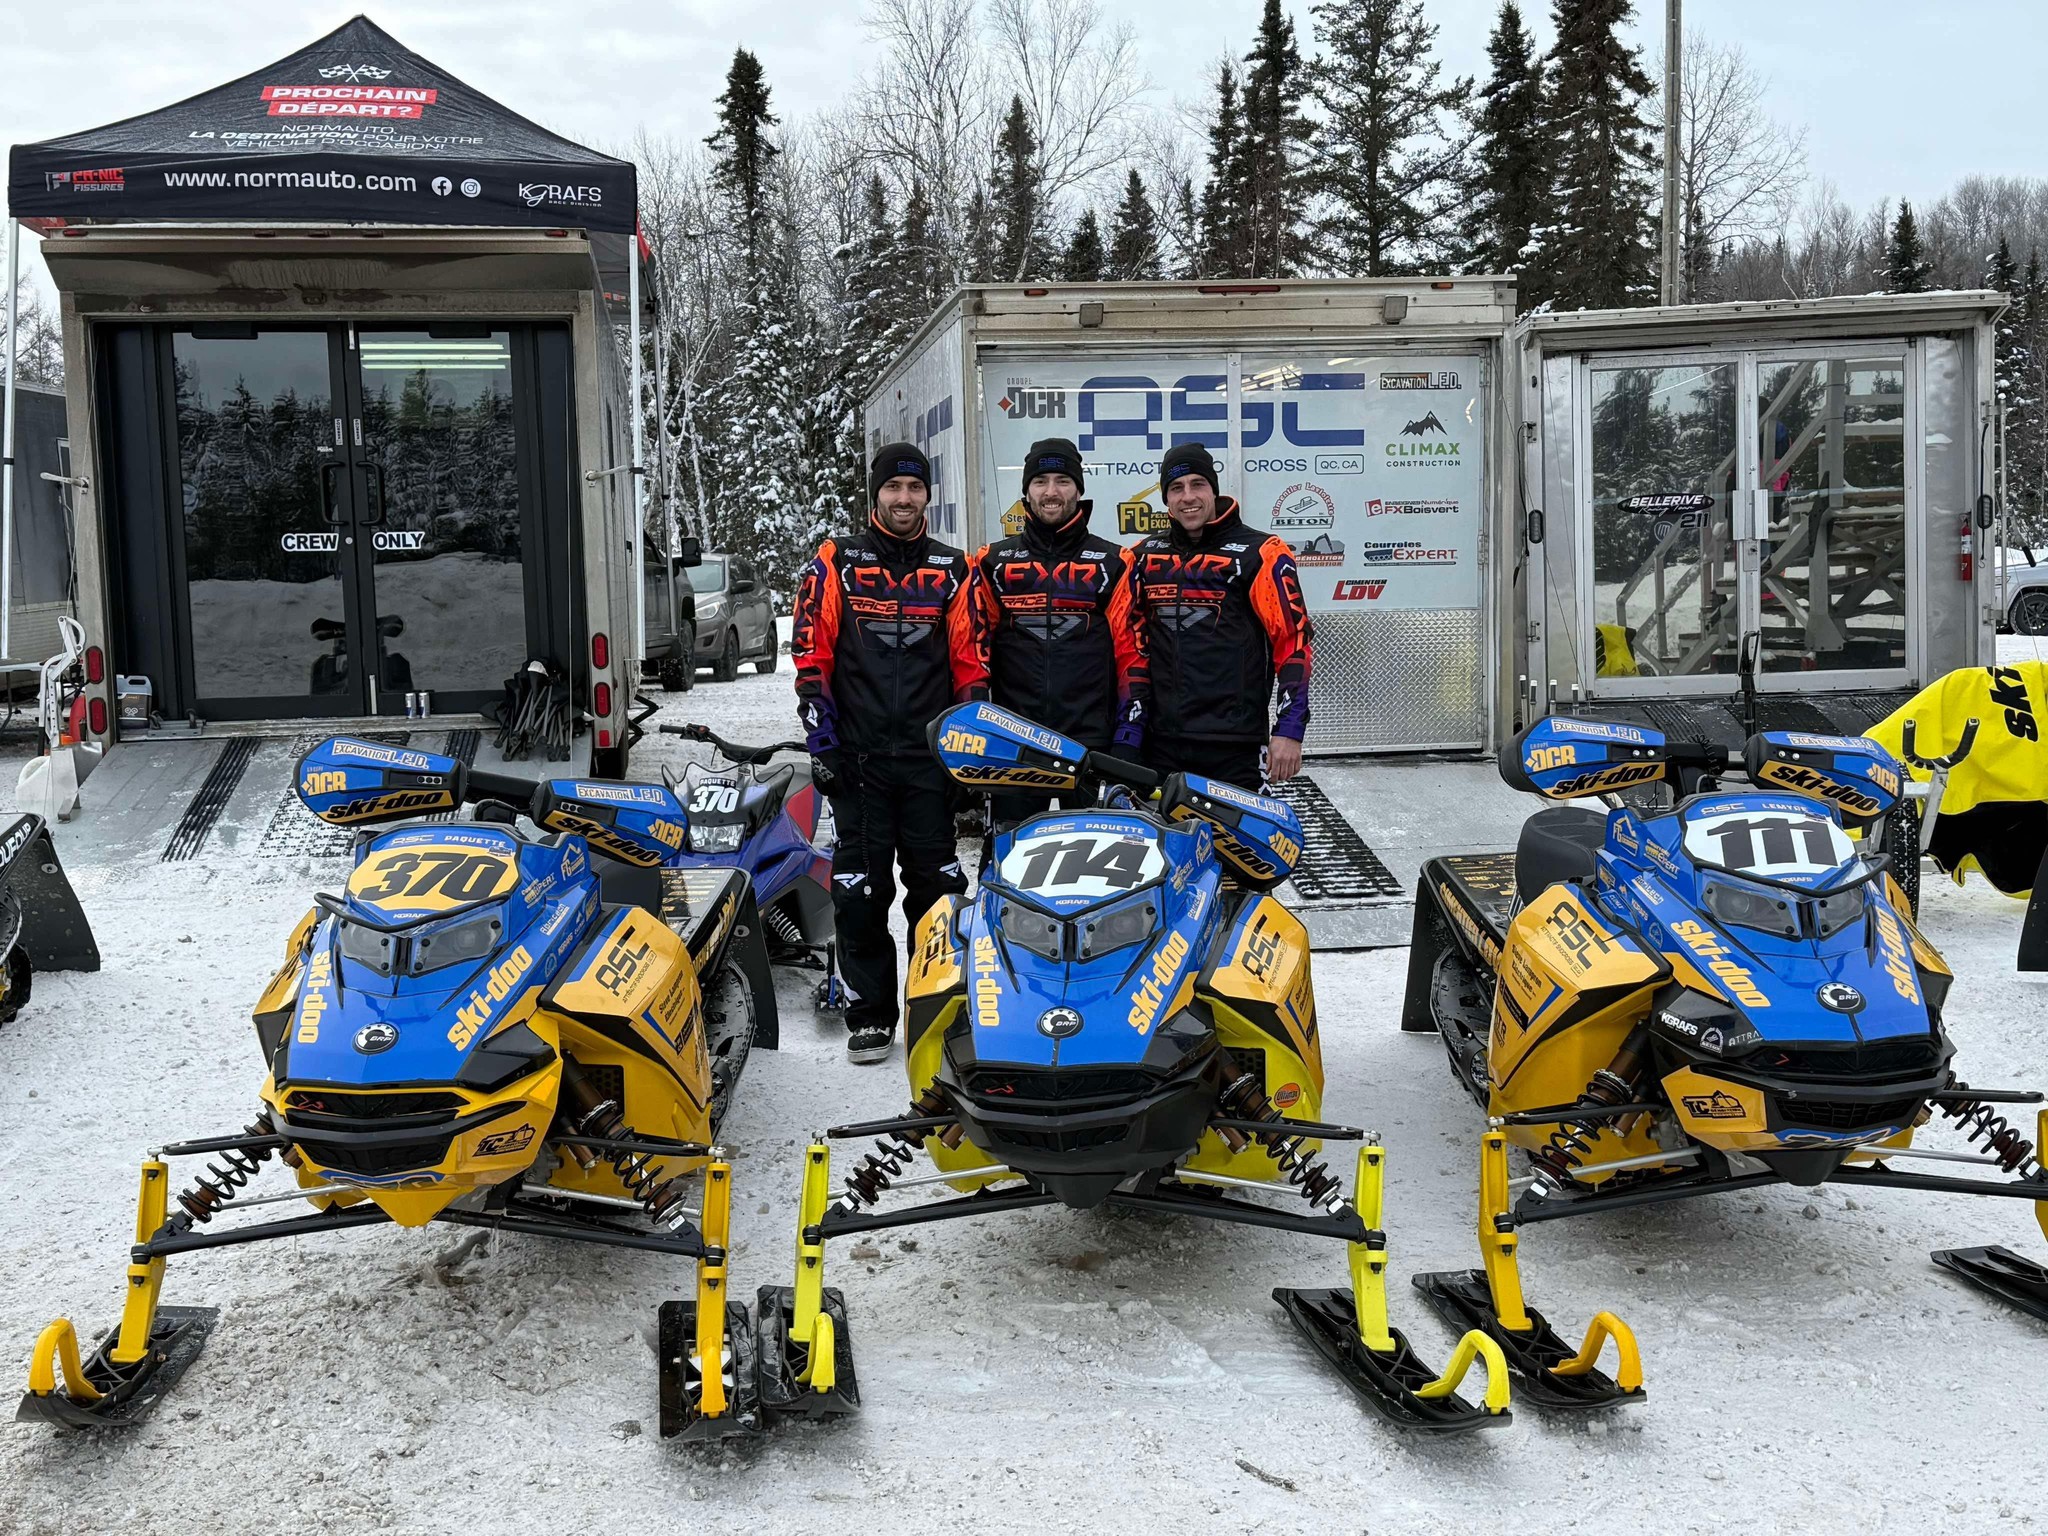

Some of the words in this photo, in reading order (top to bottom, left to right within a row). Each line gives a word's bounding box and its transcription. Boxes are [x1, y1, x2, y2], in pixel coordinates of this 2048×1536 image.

[272, 87, 428, 101] PROCHAIN
[278, 101, 413, 116] DÉPART?
[189, 130, 215, 139] LA
[220, 130, 358, 140] DESTINATION
[363, 134, 417, 143] POUR
[423, 136, 483, 145] VOTRE
[281, 124, 397, 135] NORMAUTO.
[74, 183, 125, 192] FISSURES
[164, 170, 417, 191] www.normauto.com
[1381, 376, 1428, 389] EXCAVATION
[1427, 372, 1462, 390] L.E.D.
[1007, 386, 1066, 419] DCR
[1078, 373, 1366, 451] ASC
[1385, 443, 1461, 457] CLIMAX
[1081, 462, 1162, 477] ATTRACT
[1320, 460, 1340, 471] QC,
[1341, 460, 1359, 470] CA
[1385, 460, 1461, 468] CONSTRUCTION
[1384, 505, 1460, 515] FXBoisvert
[1629, 494, 1705, 508] BELLERIVE
[1680, 512, 1710, 529] 211
[282, 534, 338, 550] CREW
[373, 533, 423, 549] ONLY
[1004, 561, 1097, 592] FXR
[1145, 553, 1233, 581] FXR
[854, 566, 947, 598] FXR
[1332, 580, 1386, 601] LDV
[850, 600, 898, 613] RACE
[1002, 595, 1048, 607] RACE
[944, 730, 987, 756] DCR
[977, 709, 1029, 737] EXCAVATION
[1027, 728, 1063, 755] L.E.D.
[1553, 721, 1606, 736] EXCAVATION
[1605, 725, 1645, 743] L.E.D.
[333, 743, 389, 760] EXCAVATION
[388, 751, 430, 769] L.E.D.
[1530, 745, 1577, 772] DCR
[306, 771, 347, 796] DCR
[955, 764, 1070, 786] ski-doo
[1551, 764, 1660, 795] ski-doo
[1871, 762, 1899, 797] DCR
[578, 786, 629, 800] EXCAVATION
[629, 788, 667, 807] L.E.D.
[688, 785, 740, 814] 370
[1769, 765, 1881, 813] ski-doo
[326, 791, 444, 820] ski-doo
[444, 835, 506, 847] PAQUETTE
[556, 816, 663, 863] ski-doo
[650, 819, 685, 850] DCR
[1085, 823, 1145, 834] PAQUETTE
[1269, 830, 1301, 869] DCR
[1706, 817, 1838, 870] 111
[356, 852, 509, 901] 370
[1017, 838, 1151, 890] 114
[1545, 900, 1611, 970] ASC
[595, 925, 651, 997] ASC
[1241, 913, 1281, 984] ASC
[1875, 905, 1920, 1006] ski-doo
[1670, 919, 1772, 1008] ski-doo
[973, 934, 1003, 1027] ski-doo
[1127, 929, 1190, 1036] ski-doo
[297, 949, 332, 1044] ski-doo
[446, 944, 533, 1052] ski-doo
[1055, 1020, 1078, 1028] BRP
[1660, 1012, 1699, 1037] KGRAFS
[369, 1035, 392, 1043] BRP
